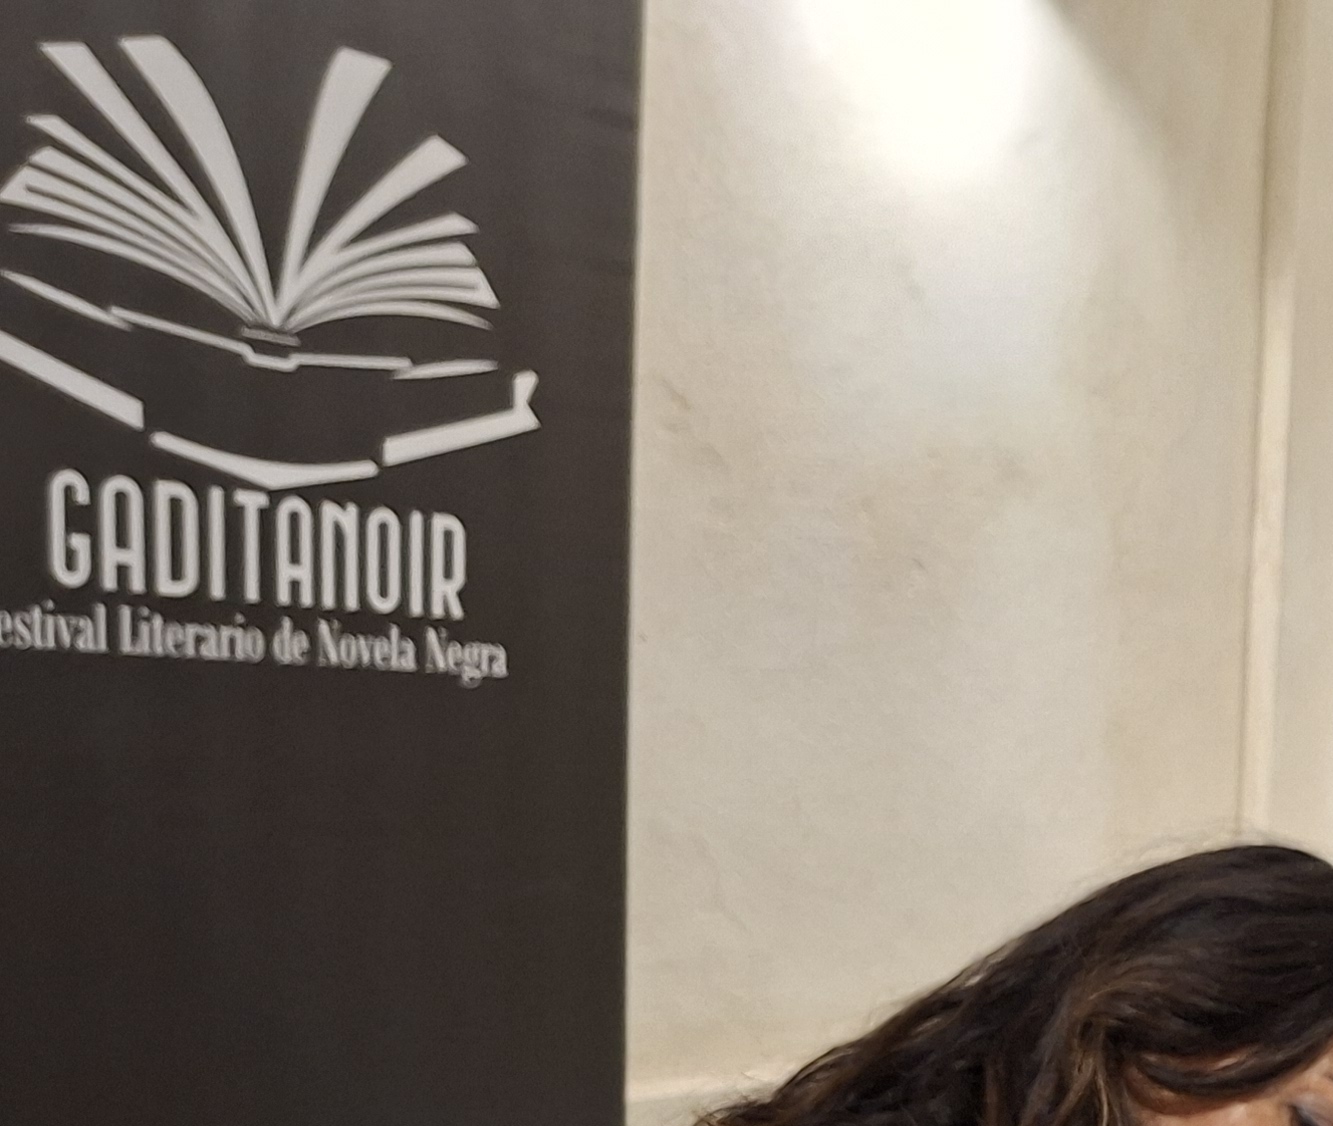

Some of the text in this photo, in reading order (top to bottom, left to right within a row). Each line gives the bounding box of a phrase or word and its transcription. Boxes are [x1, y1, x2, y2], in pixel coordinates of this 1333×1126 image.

[48, 468, 467, 620] GADITANOIR
[0, 599, 509, 688] estival Literario de Novela Negra
